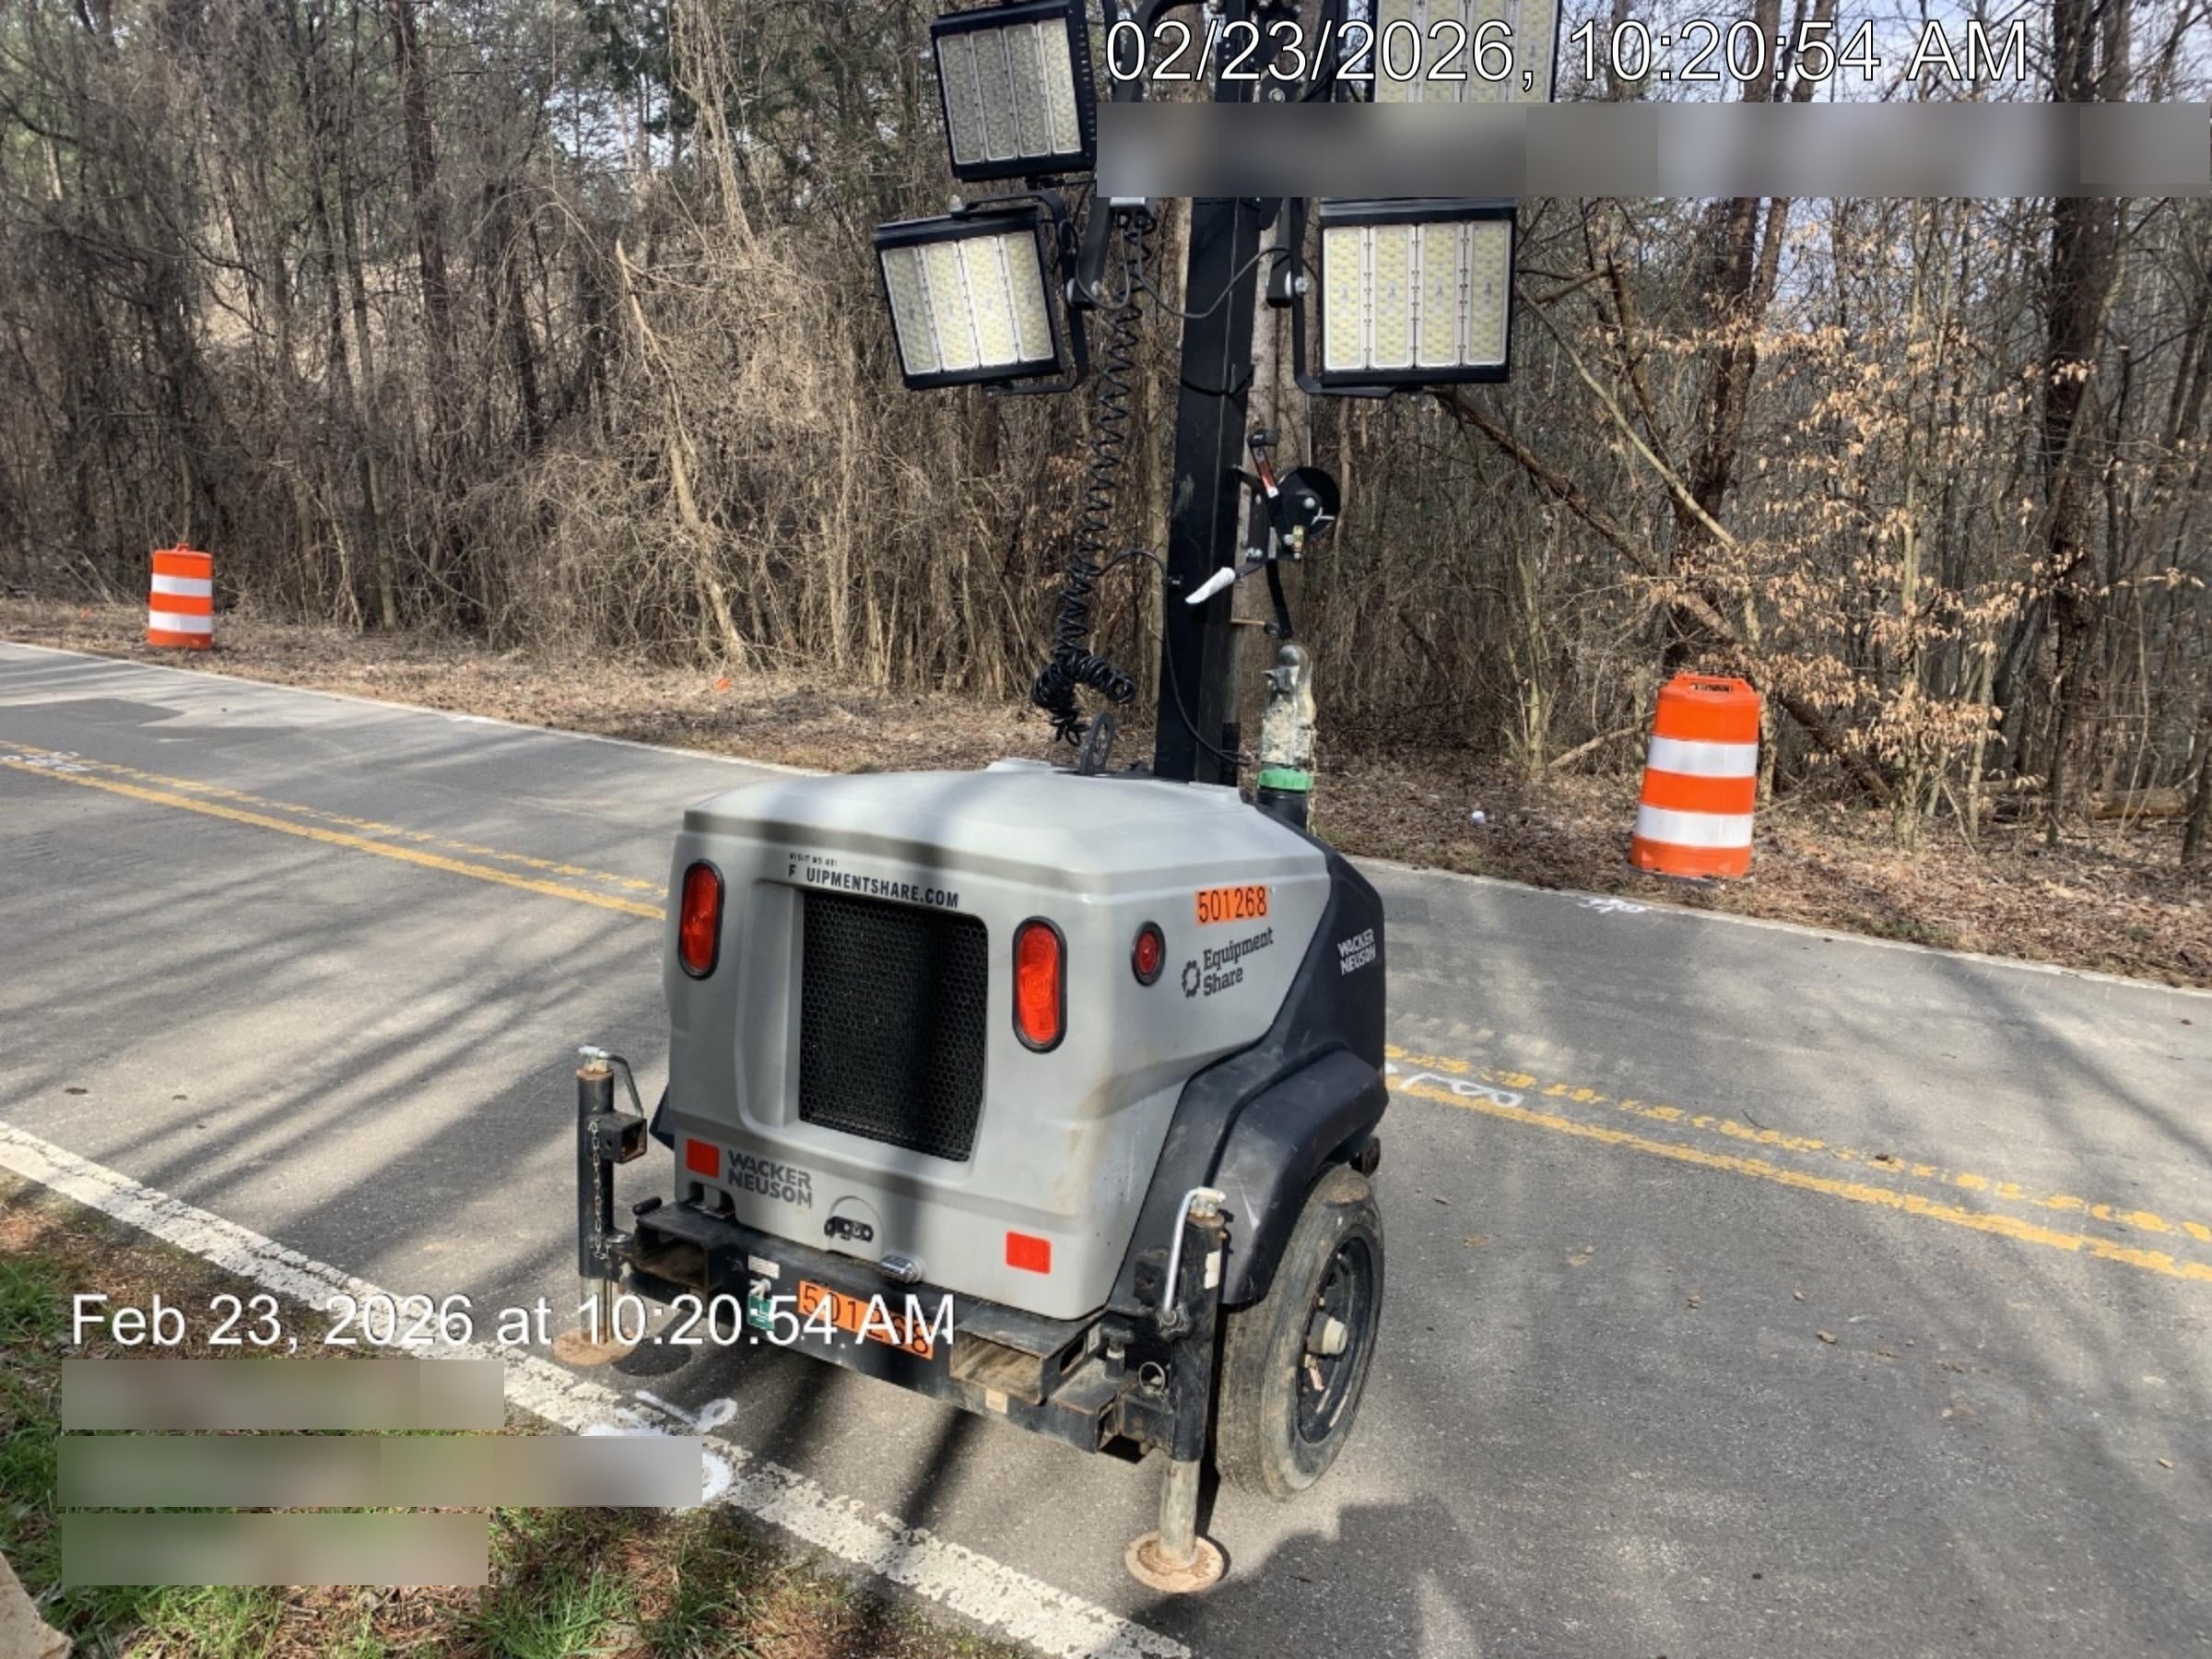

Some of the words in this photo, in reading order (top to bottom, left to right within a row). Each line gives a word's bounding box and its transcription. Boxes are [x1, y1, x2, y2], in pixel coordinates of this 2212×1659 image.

[1197, 886, 1268, 924] 501268
[1203, 926, 1275, 971] Equipment
[1336, 928, 1375, 959] WACKER
[1339, 944, 1376, 977] NEUSON
[1203, 967, 1244, 997] Share
[727, 1149, 812, 1191] WACKER
[727, 1168, 814, 1209] NEUSON
